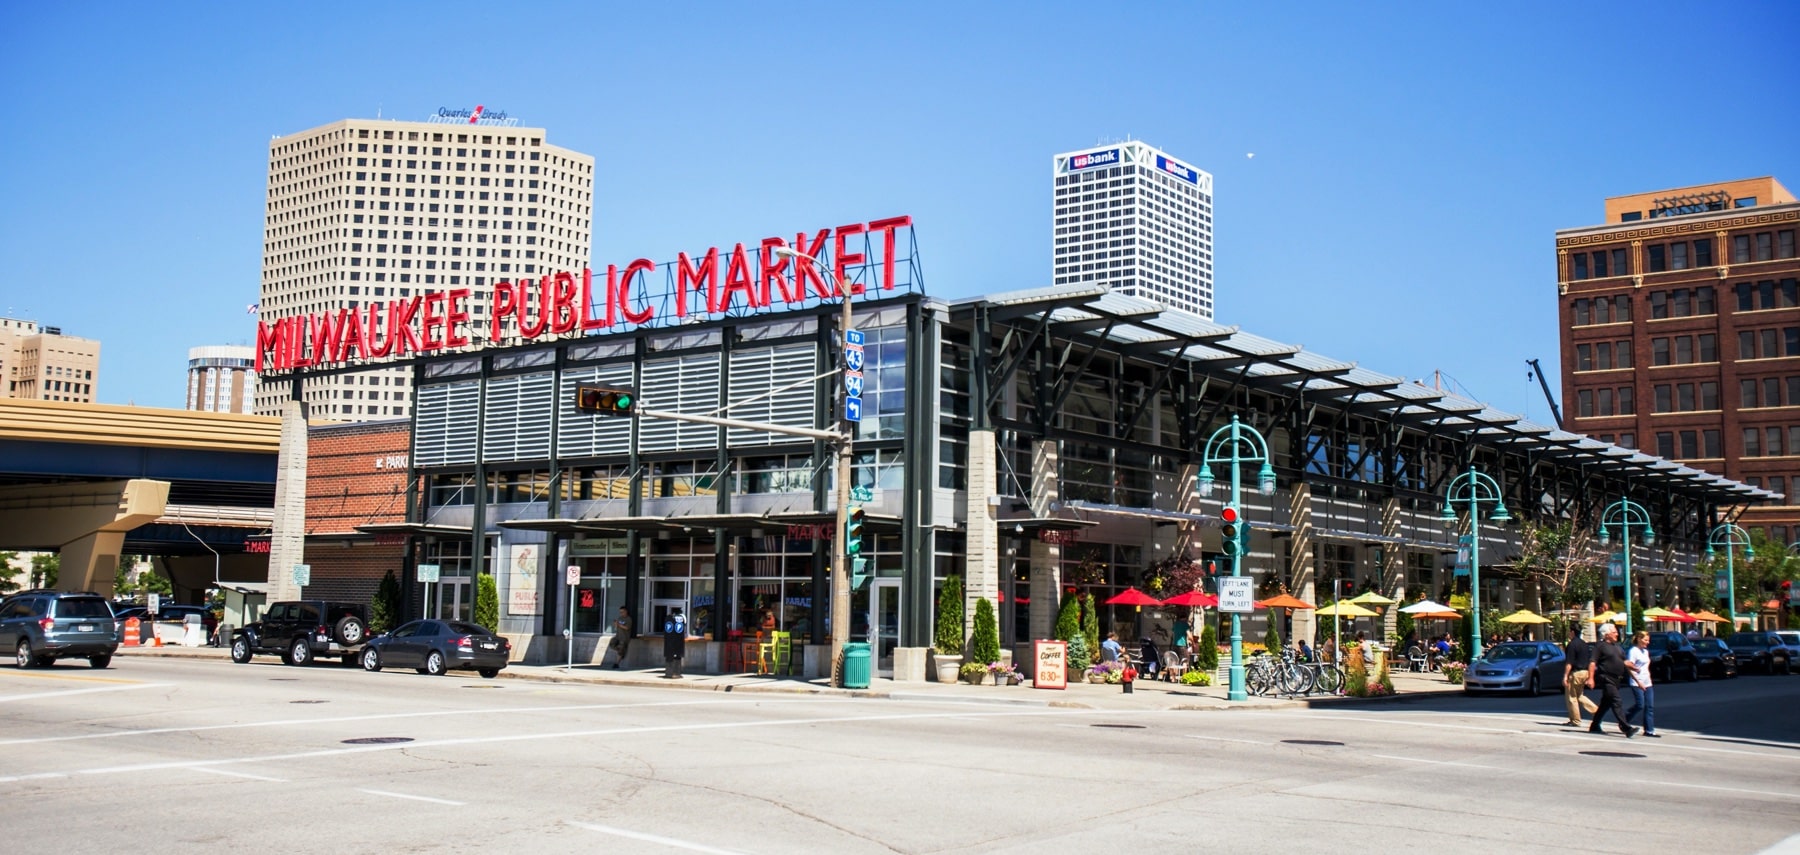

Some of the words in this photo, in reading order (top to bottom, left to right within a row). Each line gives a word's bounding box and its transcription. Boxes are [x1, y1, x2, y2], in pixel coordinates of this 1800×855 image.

[438, 106, 471, 118] Quarles
[480, 108, 507, 121] Brady
[254, 288, 470, 373] MILWAUKEE
[491, 258, 655, 342] PUBLIC
[676, 215, 912, 318] MARKET
[850, 333, 860, 343] TO
[848, 351, 863, 367] 43
[847, 378, 861, 393] 94
[386, 456, 409, 469] PARKI
[786, 524, 834, 540] MARKE
[1458, 549, 1468, 563] 10
[1611, 564, 1621, 576] 10
[1717, 579, 1728, 590] 10
[1040, 652, 1061, 660] COFFEE
